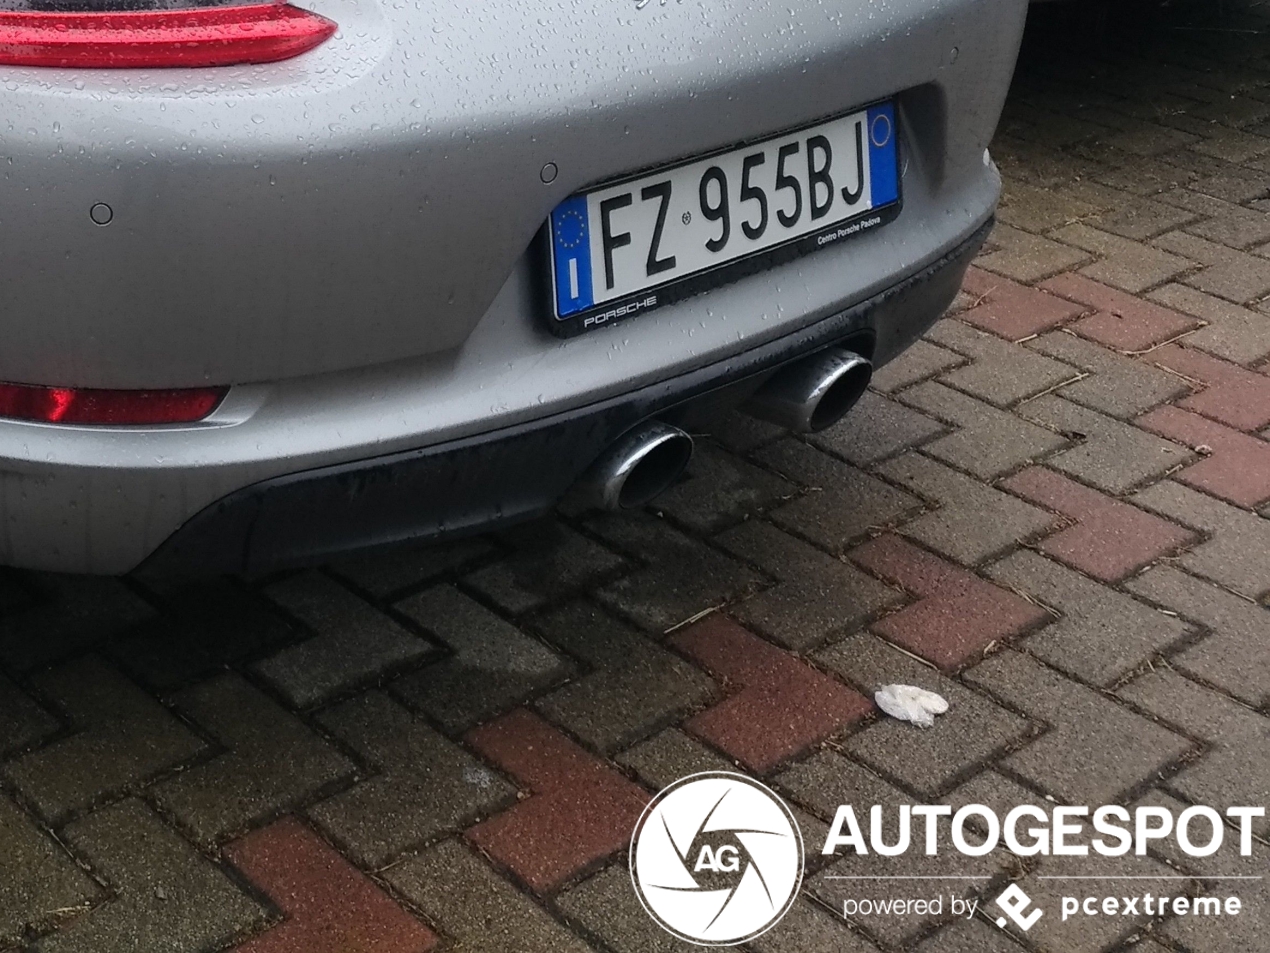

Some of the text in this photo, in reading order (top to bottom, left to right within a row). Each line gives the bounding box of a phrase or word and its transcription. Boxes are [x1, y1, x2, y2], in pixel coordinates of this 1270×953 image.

[600, 180, 677, 290] FZ
[698, 121, 864, 253] 955BJ
[817, 216, 881, 245] Centro Porsche Padova
[584, 295, 657, 328] PORSCHE
